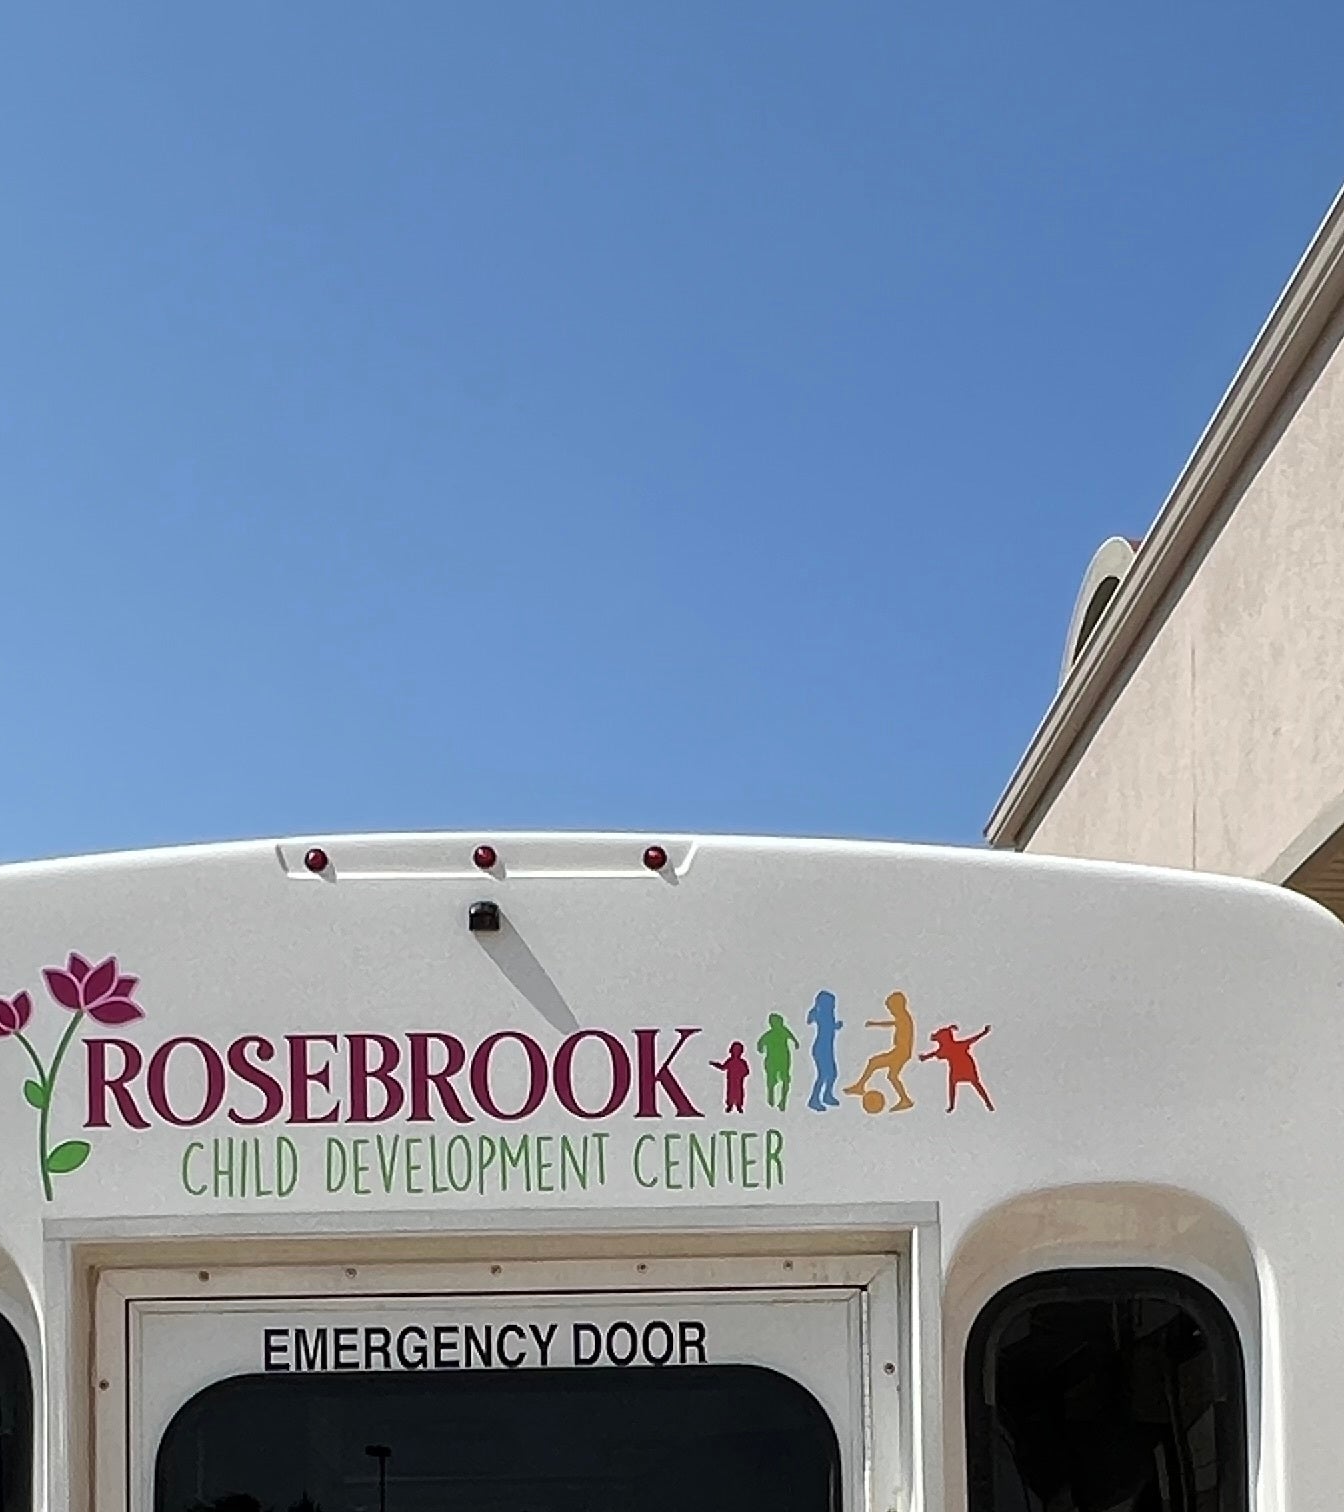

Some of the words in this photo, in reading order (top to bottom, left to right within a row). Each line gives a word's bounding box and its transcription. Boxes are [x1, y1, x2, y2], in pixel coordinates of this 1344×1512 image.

[81, 1027, 706, 1130] ROSEBROOK
[181, 1139, 301, 1199] CHILD
[325, 1132, 611, 1196] DEVELOPMENT
[632, 1128, 787, 1191] CENTER
[263, 1323, 558, 1371] EMERGENCY
[572, 1320, 708, 1367] DOOR
